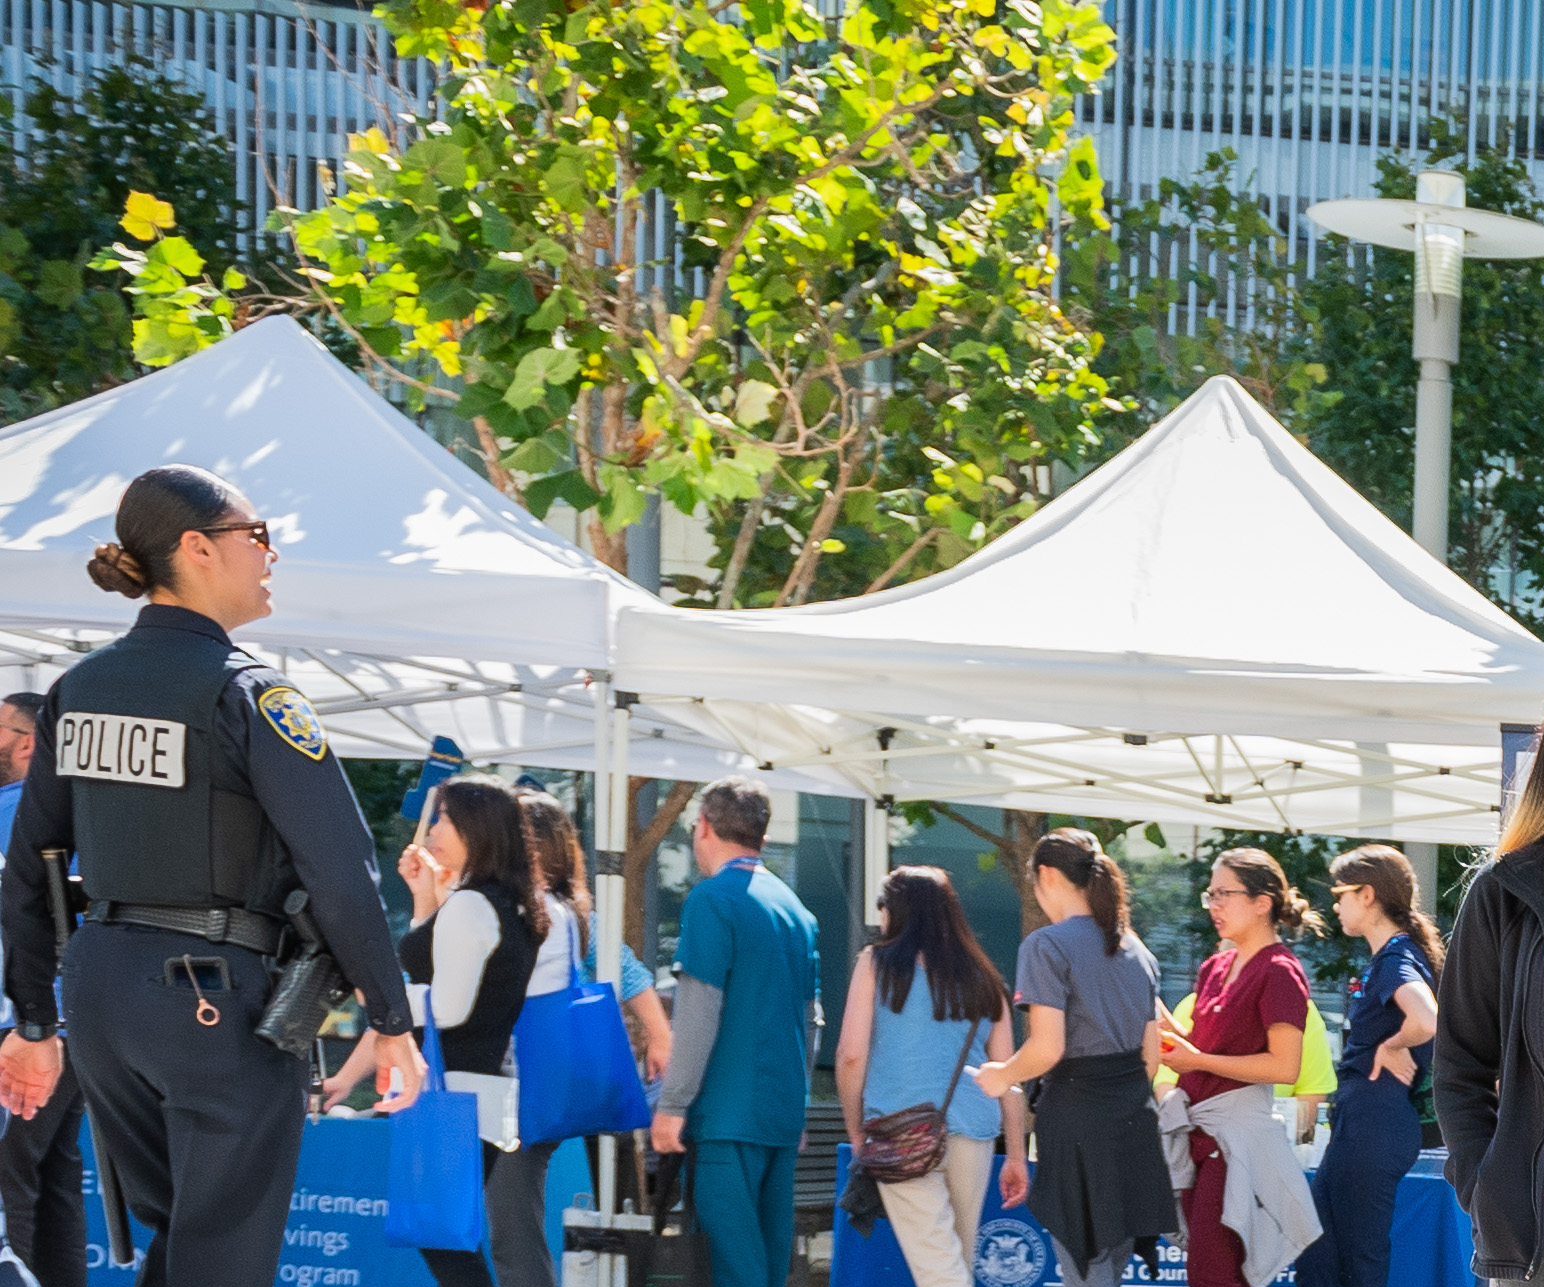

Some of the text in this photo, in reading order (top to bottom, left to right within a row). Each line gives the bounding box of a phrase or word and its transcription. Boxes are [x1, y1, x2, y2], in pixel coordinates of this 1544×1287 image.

[60, 718, 170, 779] POLICE
[289, 1187, 390, 1217] tiremen
[284, 1223, 350, 1256] vings
